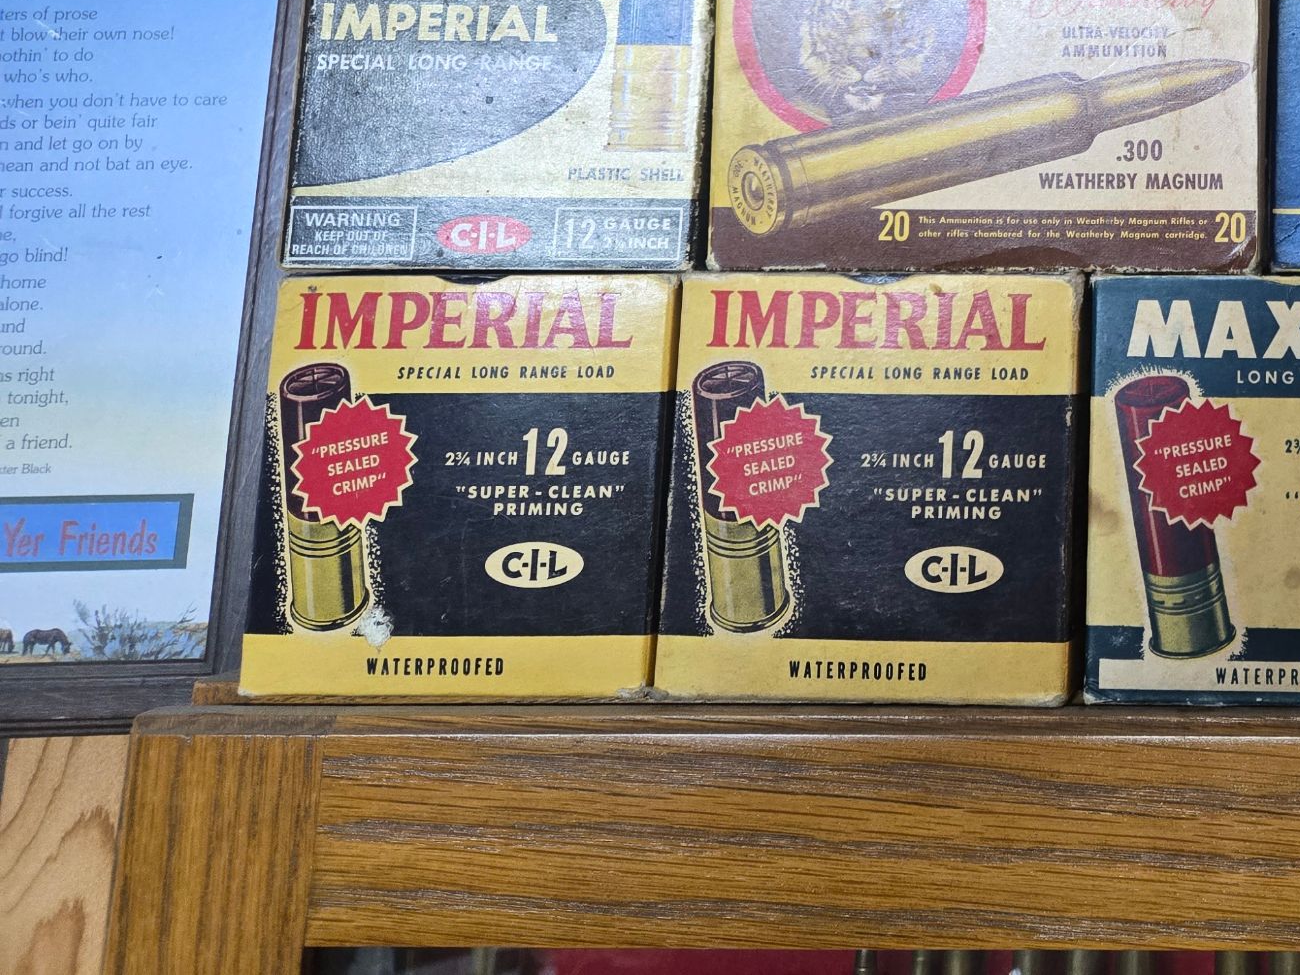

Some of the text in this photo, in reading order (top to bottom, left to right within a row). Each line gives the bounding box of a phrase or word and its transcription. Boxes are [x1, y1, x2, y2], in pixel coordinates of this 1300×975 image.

[320, 3, 557, 43] IMPERIAL
[11, 27, 175, 41] blow their own nose!
[1062, 46, 1167, 57] AMMUNITION
[317, 54, 553, 72] SPECIAL LONG RANGE
[50, 97, 78, 111] you
[130, 93, 167, 106] have
[173, 94, 189, 106] to
[194, 95, 227, 106] care
[1116, 140, 1163, 162] .300
[40, 157, 192, 173] and not bat an eye.
[1039, 174, 1223, 190] WEATHERBY MAGNUM
[12, 187, 73, 197] success.
[10, 204, 150, 222] forgive all the rest
[305, 213, 400, 226] WARNING
[919, 216, 1167, 227] This Ammunition Weatherby Magnum
[604, 219, 670, 230] GAUGE
[879, 211, 910, 241] 20
[1215, 212, 1246, 243] 20
[1165, 231, 1207, 240] cartridge.
[25, 247, 67, 262] blind!
[294, 290, 633, 350] IMPERIAL
[706, 290, 1047, 351] IMPERIAL
[397, 366, 614, 379] SPECIAL LONG RANGE LOAD
[1237, 370, 1294, 385] LONG
[8, 389, 69, 407] tonight,
[21, 433, 73, 449] friend.
[893, 430, 1047, 479] INCH 12 GAUGE
[21, 464, 51, 474] Black
[1175, 458, 1227, 478] SEALED
[911, 505, 1002, 520] PRIMING
[4, 517, 158, 557] Yer Friends
[366, 658, 504, 676] WATERPROOFED
[790, 661, 928, 681] WATERPROOFED
